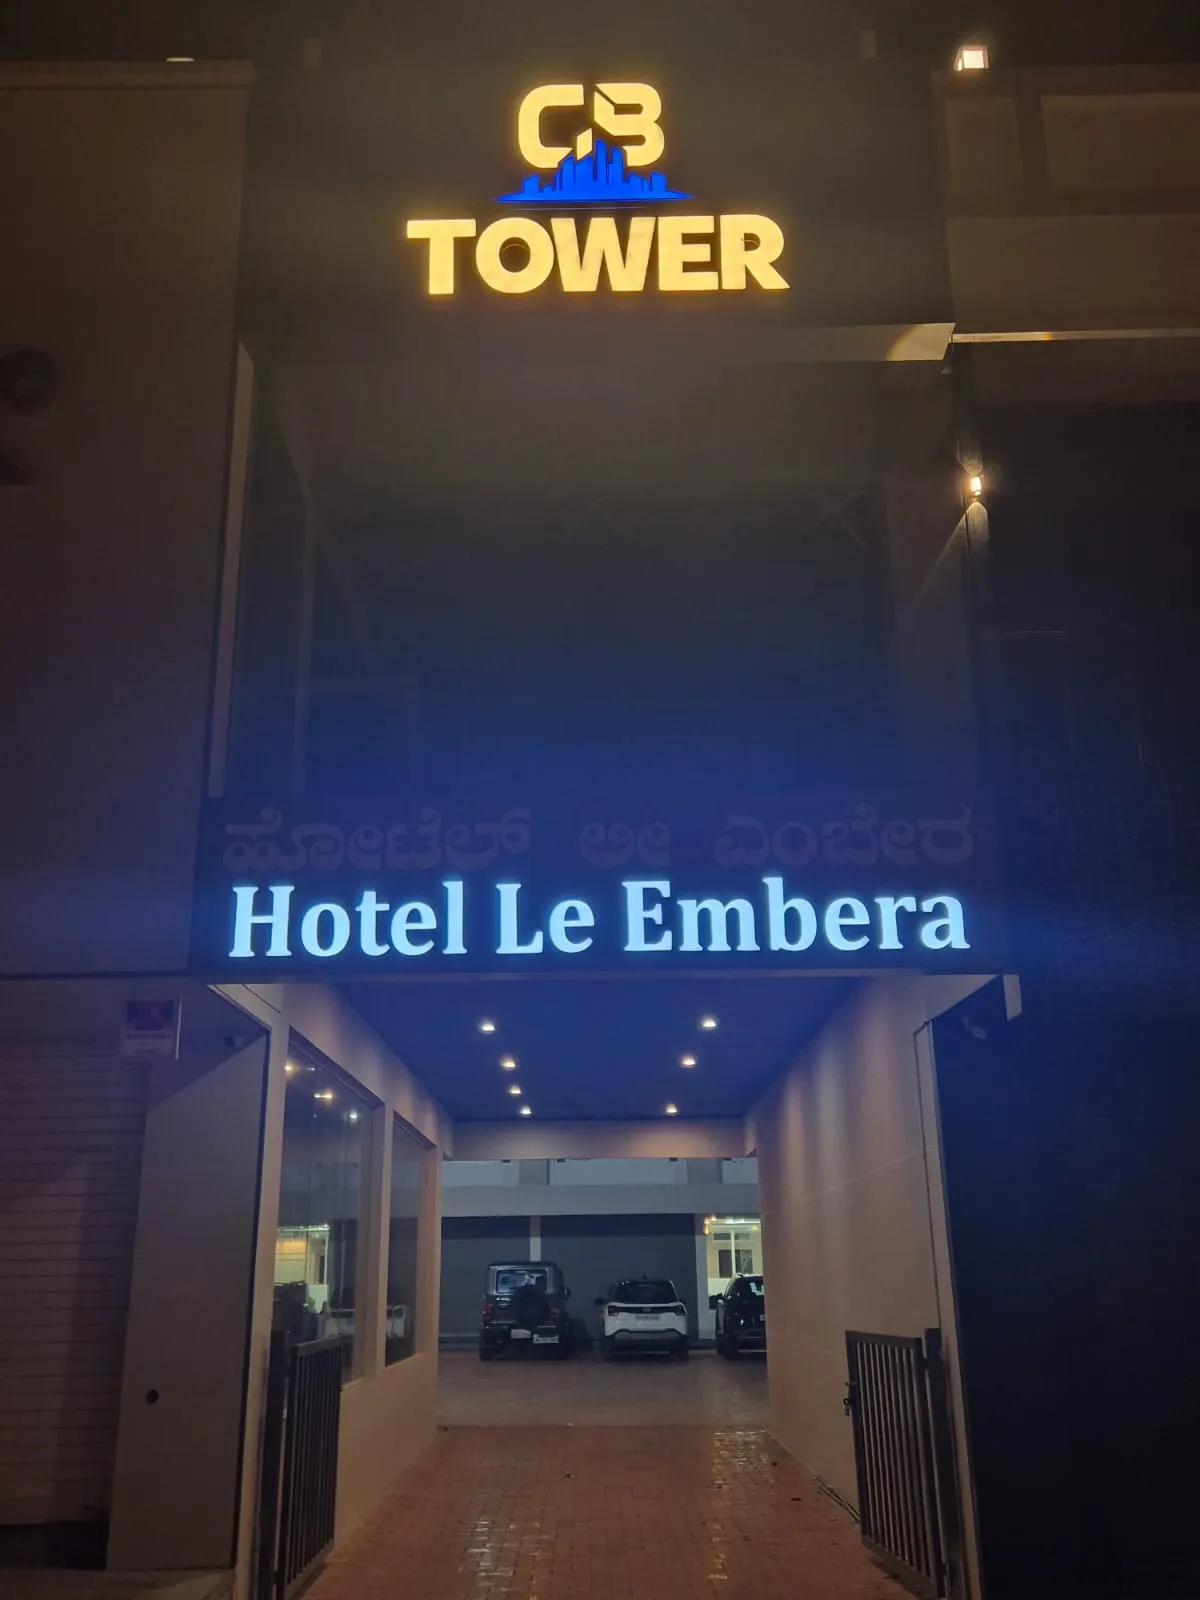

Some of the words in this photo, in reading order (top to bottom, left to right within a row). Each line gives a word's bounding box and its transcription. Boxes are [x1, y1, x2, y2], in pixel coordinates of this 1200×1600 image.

[518, 82, 665, 169] CB
[406, 213, 790, 295] TOWER
[228, 880, 468, 958] Hotel
[495, 883, 595, 954] Le
[621, 876, 971, 952] Embera
